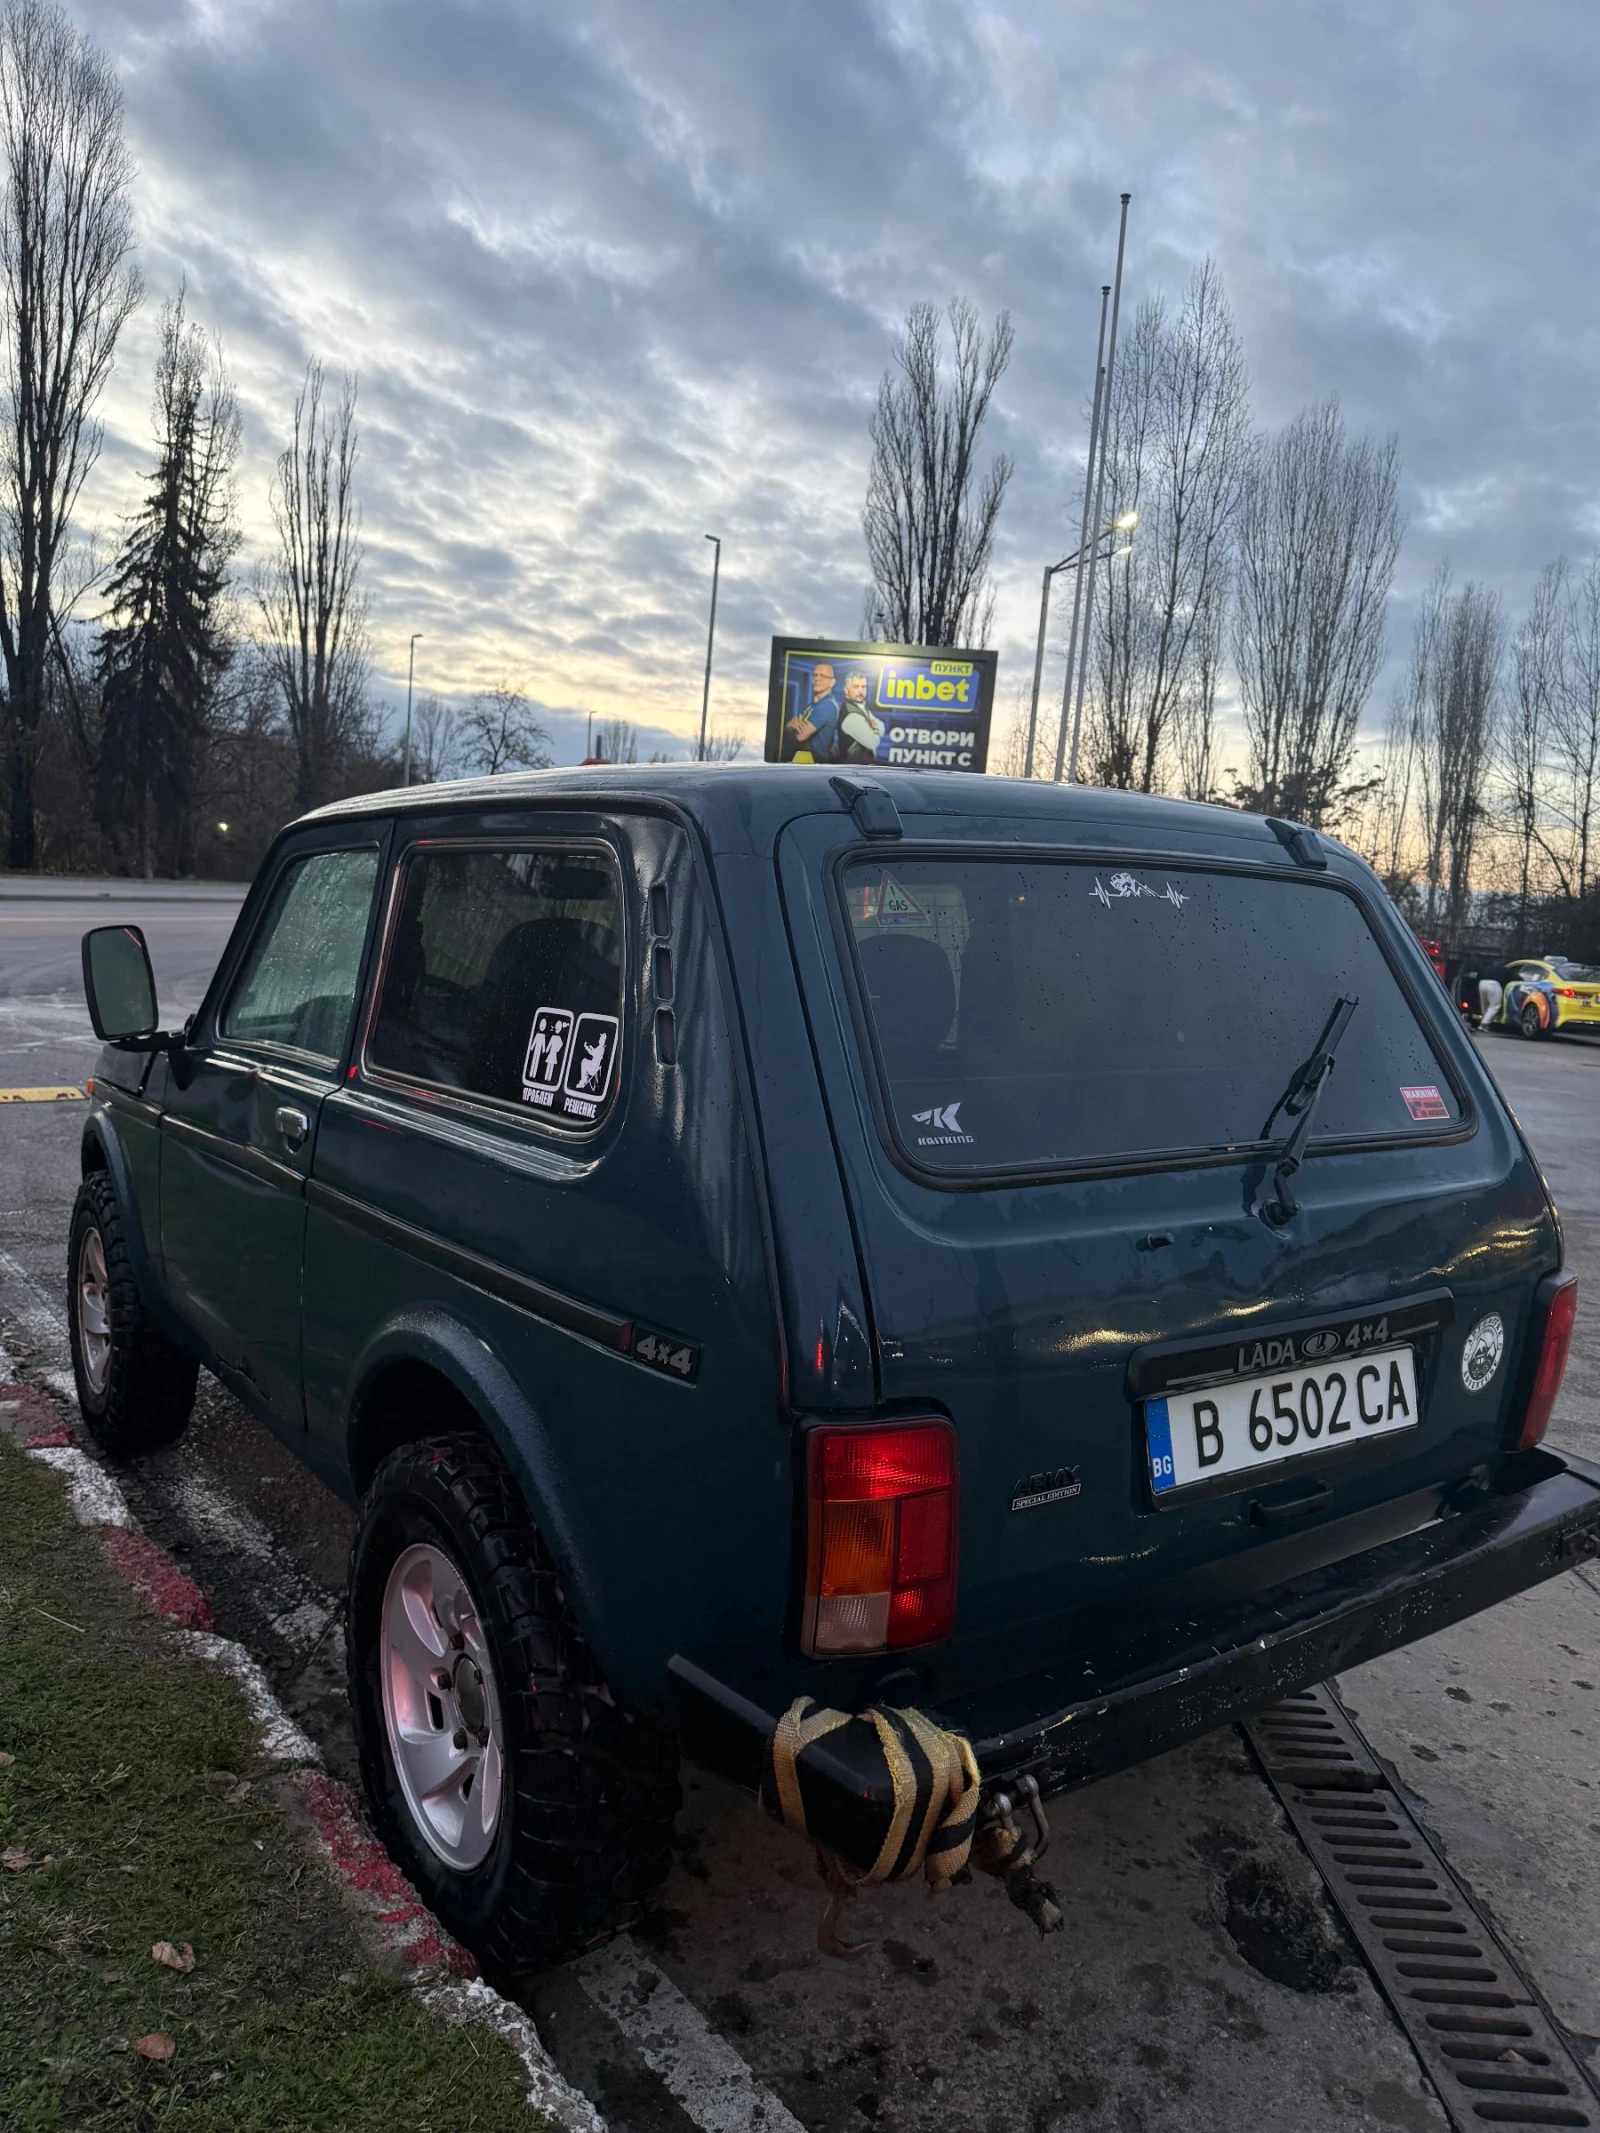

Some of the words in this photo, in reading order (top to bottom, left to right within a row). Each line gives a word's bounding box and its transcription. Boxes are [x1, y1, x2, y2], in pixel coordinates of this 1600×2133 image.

[934, 663, 971, 674] ПУНКТ
[887, 671, 970, 702] inbet
[889, 727, 975, 747] ОТВОРИ
[888, 747, 956, 765] ПУНКТ
[957, 752, 972, 767] С
[888, 900, 909, 911] GAS
[522, 1087, 554, 1107] ПРОБЛЕМ
[1404, 1089, 1439, 1099] WARNING
[563, 1097, 597, 1119] РЕШЕНИЕ
[636, 1334, 693, 1375] 4x4
[1238, 1338, 1297, 1373] LADA
[1345, 1317, 1389, 1350] 4x4
[1192, 1400, 1225, 1468] B
[1152, 1455, 1172, 1478] BG
[1016, 1494, 1047, 1508] SPECIAL
[1047, 1486, 1078, 1500] EDITION
